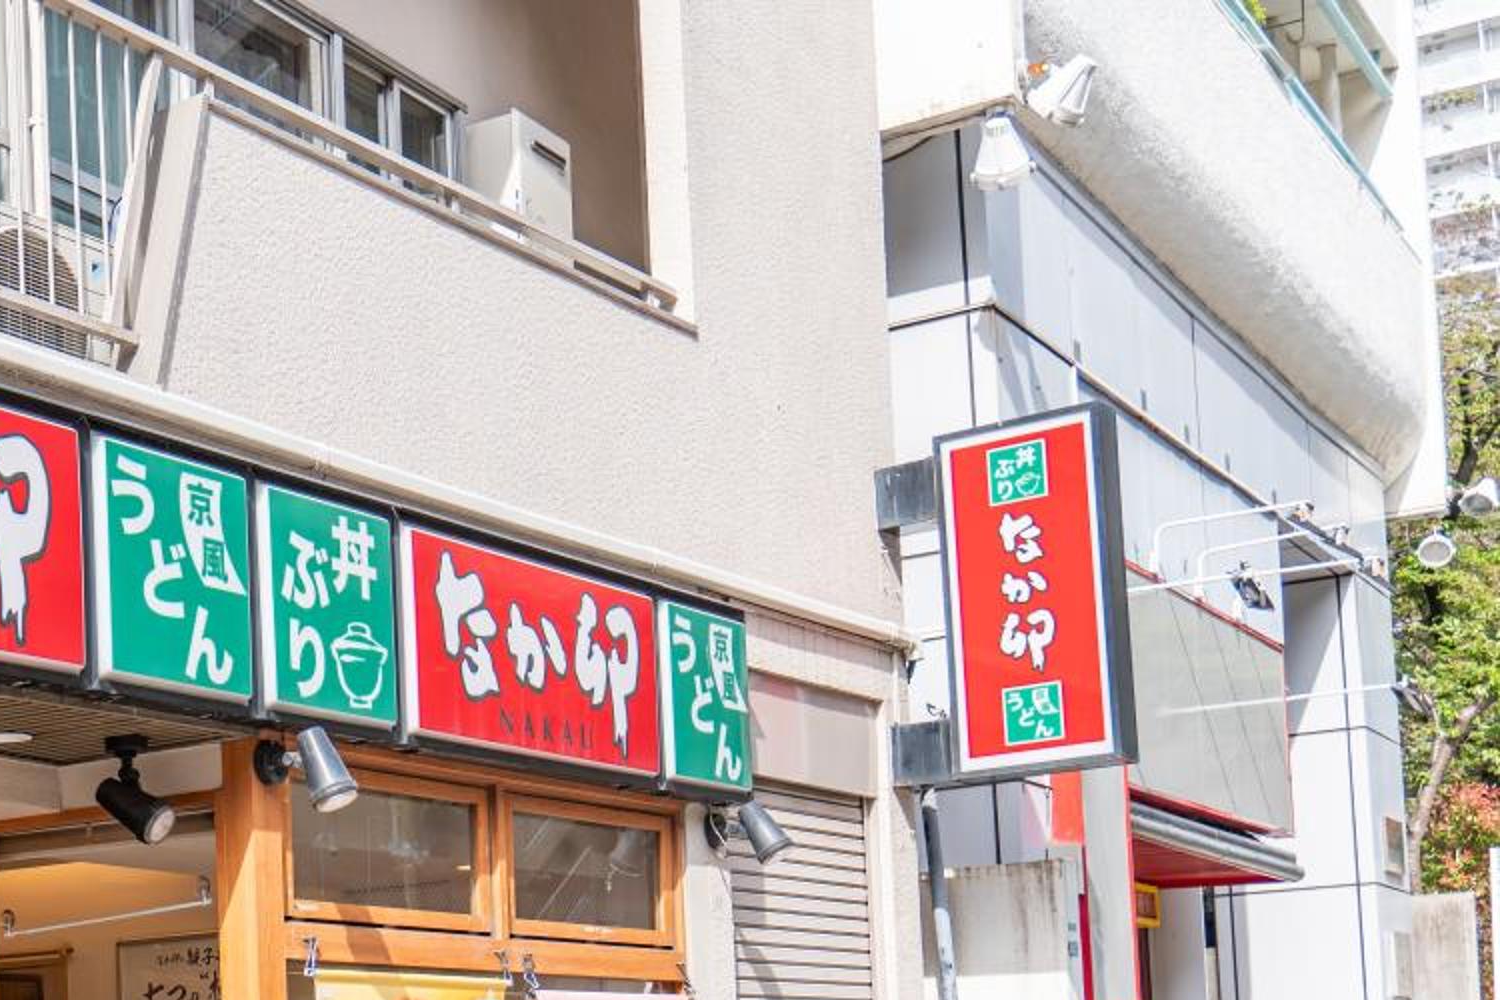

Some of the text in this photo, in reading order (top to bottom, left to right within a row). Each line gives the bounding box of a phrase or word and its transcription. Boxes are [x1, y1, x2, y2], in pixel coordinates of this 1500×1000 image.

[435, 549, 640, 760] なか卯
[998, 511, 1056, 673] なか卯
[499, 708, 594, 749] NAKAU
